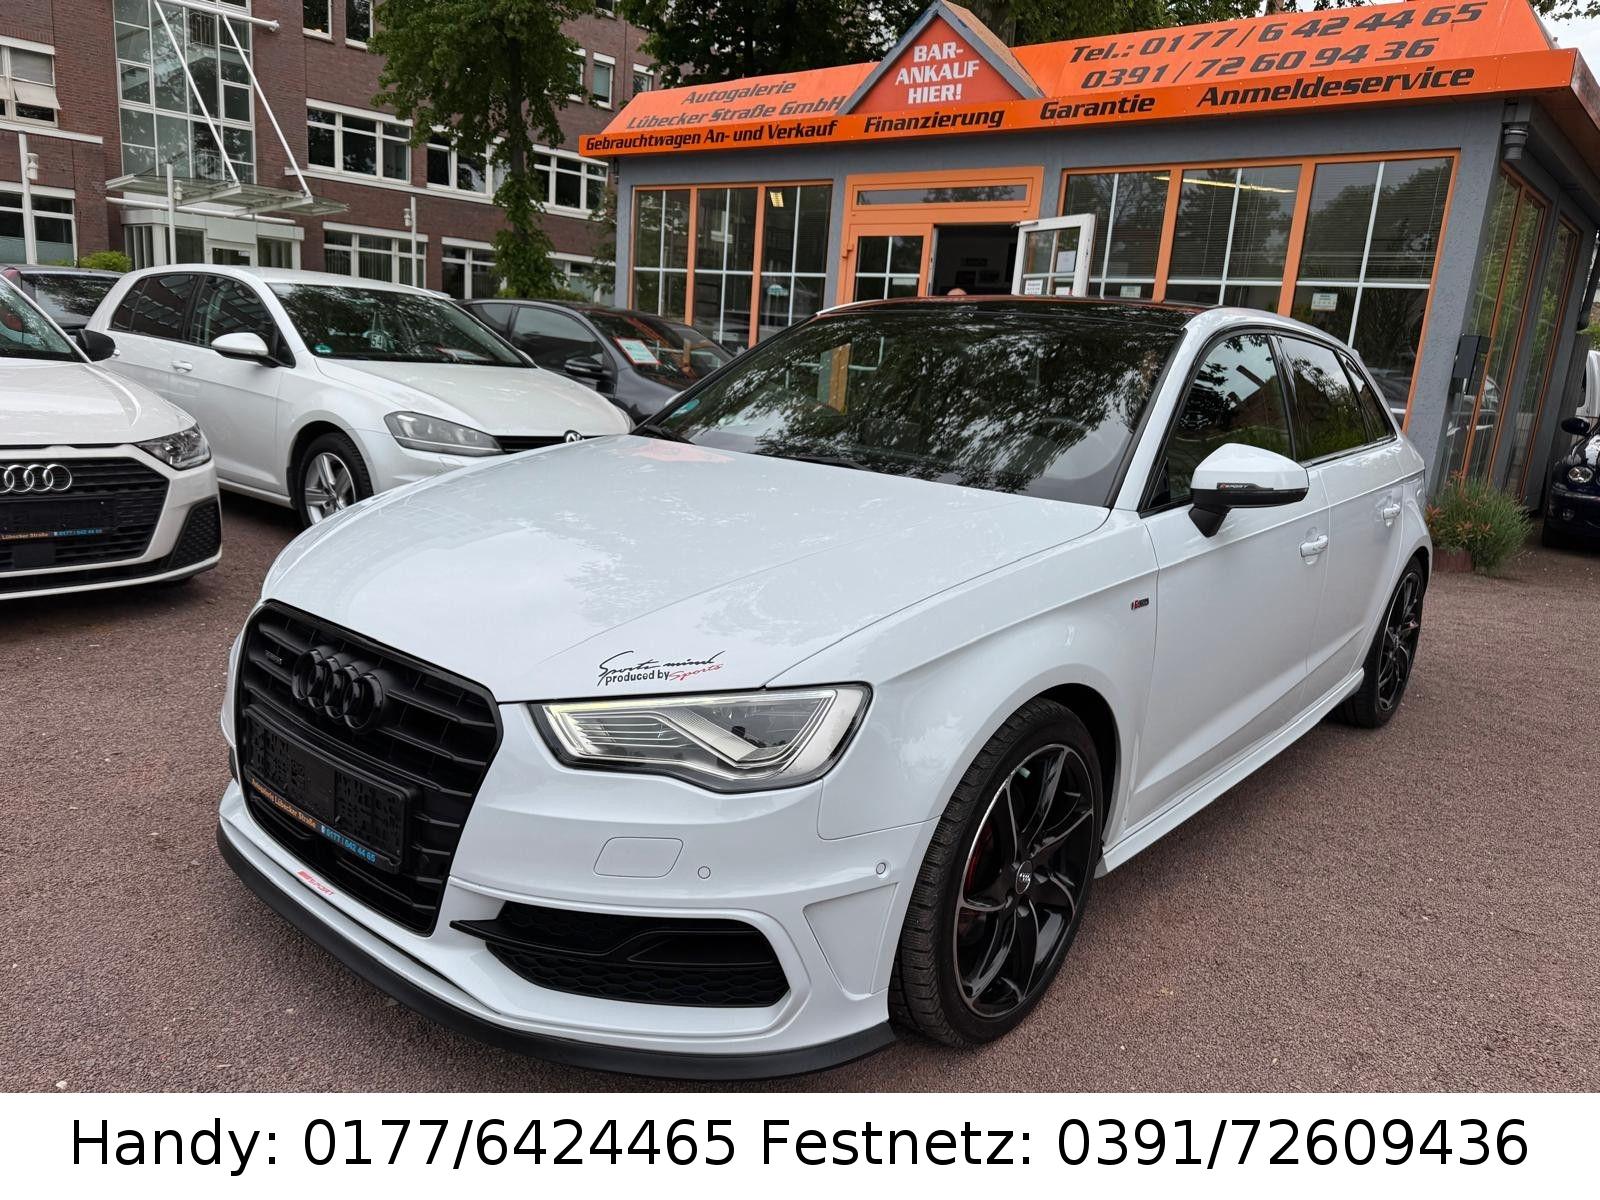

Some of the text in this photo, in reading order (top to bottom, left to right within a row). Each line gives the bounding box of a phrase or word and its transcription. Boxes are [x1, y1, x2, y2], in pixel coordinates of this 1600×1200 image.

[913, 42, 963, 63] BAR-
[1070, 43, 1135, 63] Tel.:
[1081, 63, 1170, 90] 0391
[1250, 50, 1307, 74] 60
[1310, 44, 1371, 68] 94
[1375, 37, 1441, 62] 36
[895, 60, 980, 87] ANKAUF
[681, 80, 797, 105] Autogalerie
[907, 83, 962, 104] HIER!
[1197, 66, 1476, 108] Anmeldeservice
[626, 95, 848, 130] Lübecker Straße GmbH
[1040, 93, 1156, 121] Garantie
[864, 108, 1005, 134] Finanzierung
[585, 119, 839, 152] Gebrauchtwagen An- und Verkauf
[605, 670, 655, 686] produced
[657, 670, 670, 681] by
